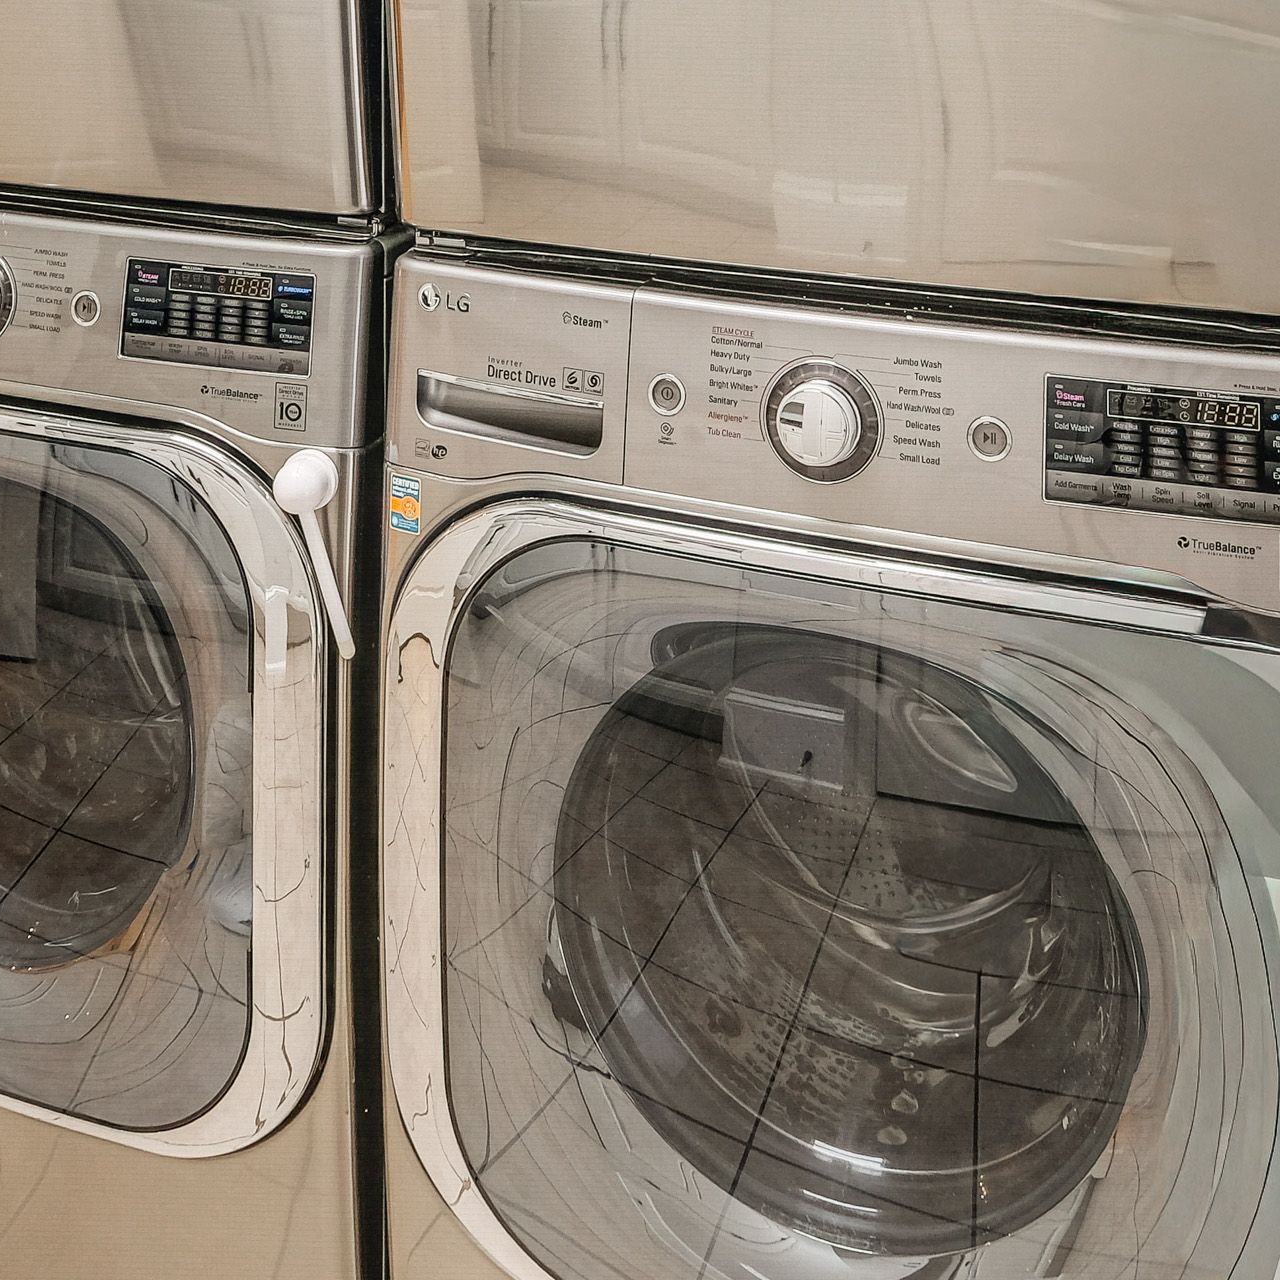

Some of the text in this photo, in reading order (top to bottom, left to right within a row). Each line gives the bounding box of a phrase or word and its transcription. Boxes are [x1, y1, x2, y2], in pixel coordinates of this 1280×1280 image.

[445, 292, 471, 313] LG
[572, 315, 602, 329] Steam
[712, 326, 754, 337] STEAM CYCLE
[711, 336, 763, 349] Cotton/Normal
[487, 355, 523, 368] Inverter
[710, 349, 751, 362] Heavy Duty
[893, 357, 942, 369] Jumbo Wash
[487, 365, 556, 388] Direct Drive
[710, 364, 752, 377] Bulky/Large
[914, 372, 942, 383] Towels
[709, 378, 753, 392] Bright Whites
[209, 386, 259, 400] TrueBalance
[920, 388, 942, 399] Press
[1063, 392, 1085, 401] Steam
[708, 395, 738, 408] Sanitary
[1072, 400, 1086, 408] Care
[279, 401, 302, 421] 10
[886, 401, 941, 415] Hand Wash/Wool
[707, 411, 743, 423] Allergiene
[905, 420, 941, 432] Delicates
[1054, 421, 1090, 433] Cold Wash
[707, 427, 741, 439] Tub Clean
[893, 435, 941, 448] Speed Wash
[899, 452, 941, 465] Small Load
[1054, 452, 1094, 464] Delay Wash
[1054, 480, 1098, 491] Add Garments
[1112, 482, 1131, 491] Wash
[1155, 487, 1171, 496] Spin
[1151, 495, 1174, 505] Speed
[1197, 492, 1210, 500] Soil
[1193, 499, 1213, 509] Level
[1233, 499, 1256, 509] Signal
[1191, 538, 1256, 555] TrueBalance
